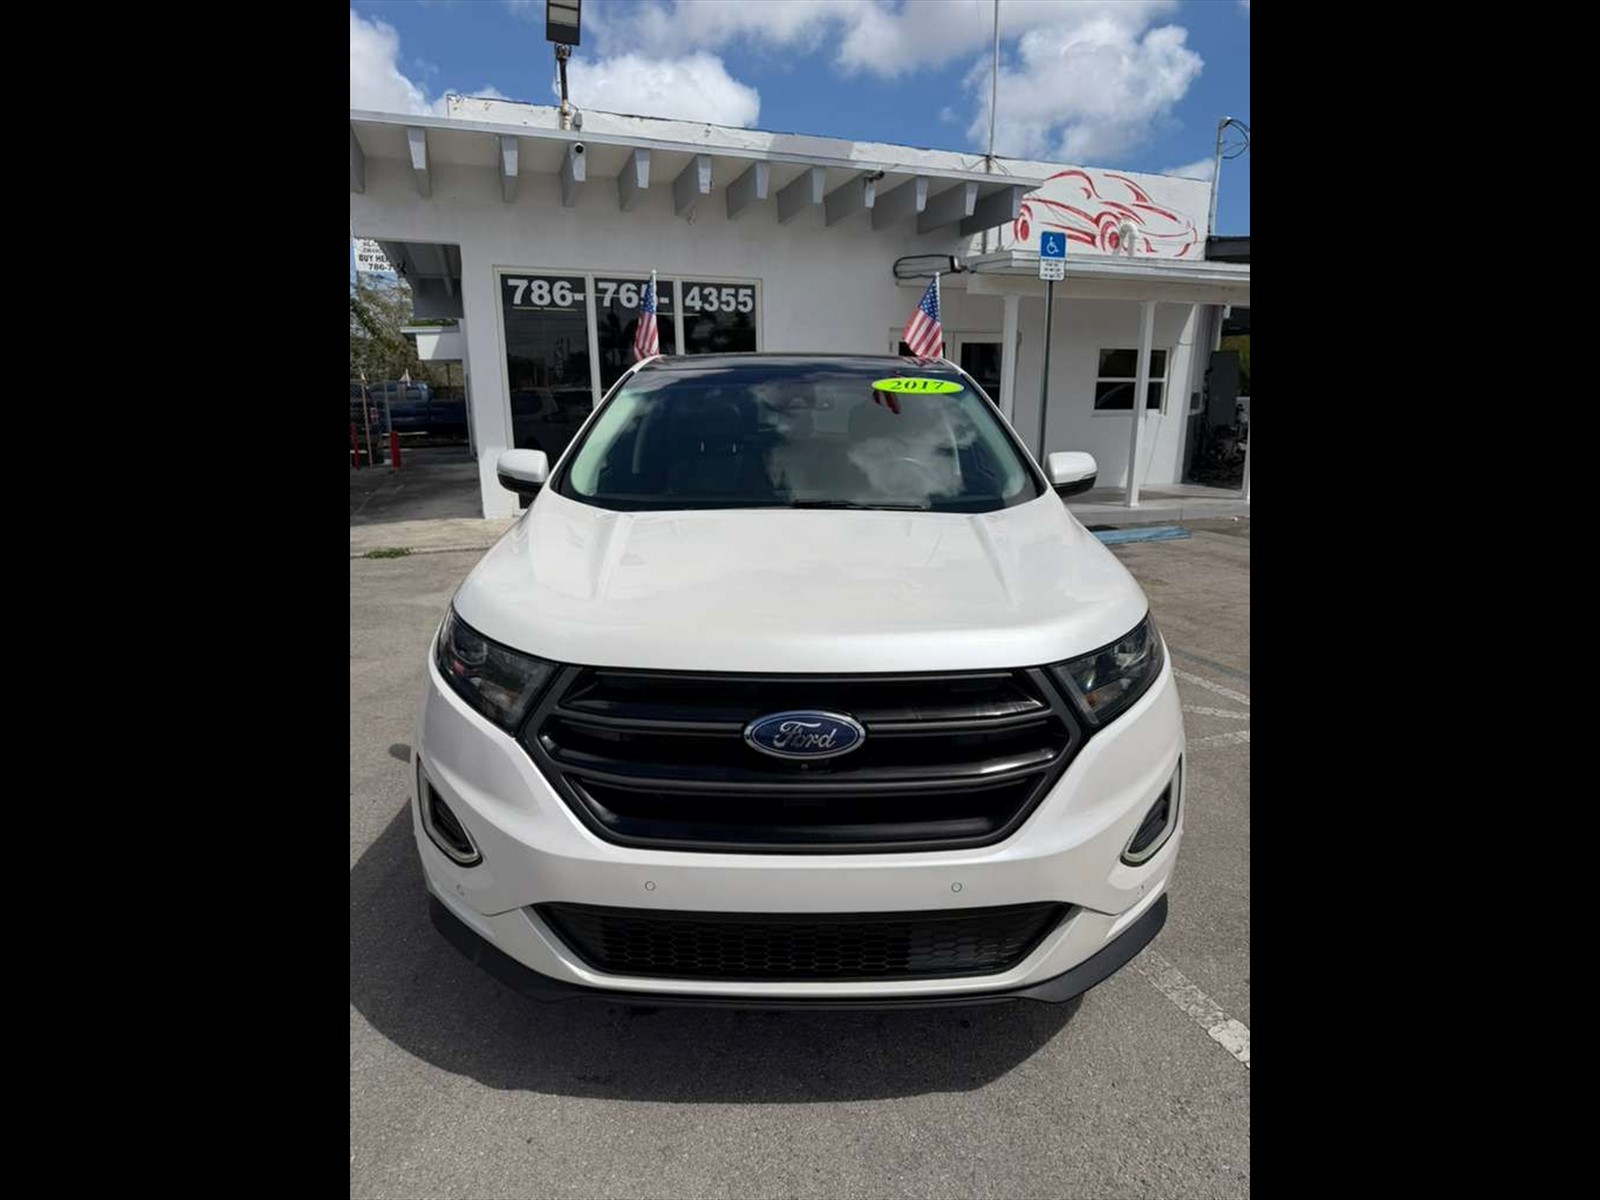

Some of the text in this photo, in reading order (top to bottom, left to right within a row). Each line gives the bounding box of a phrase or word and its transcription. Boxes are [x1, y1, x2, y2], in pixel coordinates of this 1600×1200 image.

[359, 254, 374, 262] BUY
[507, 278, 585, 307] 786-
[684, 286, 754, 313] 4355
[890, 380, 944, 390] 2017
[773, 721, 837, 748] Ford
